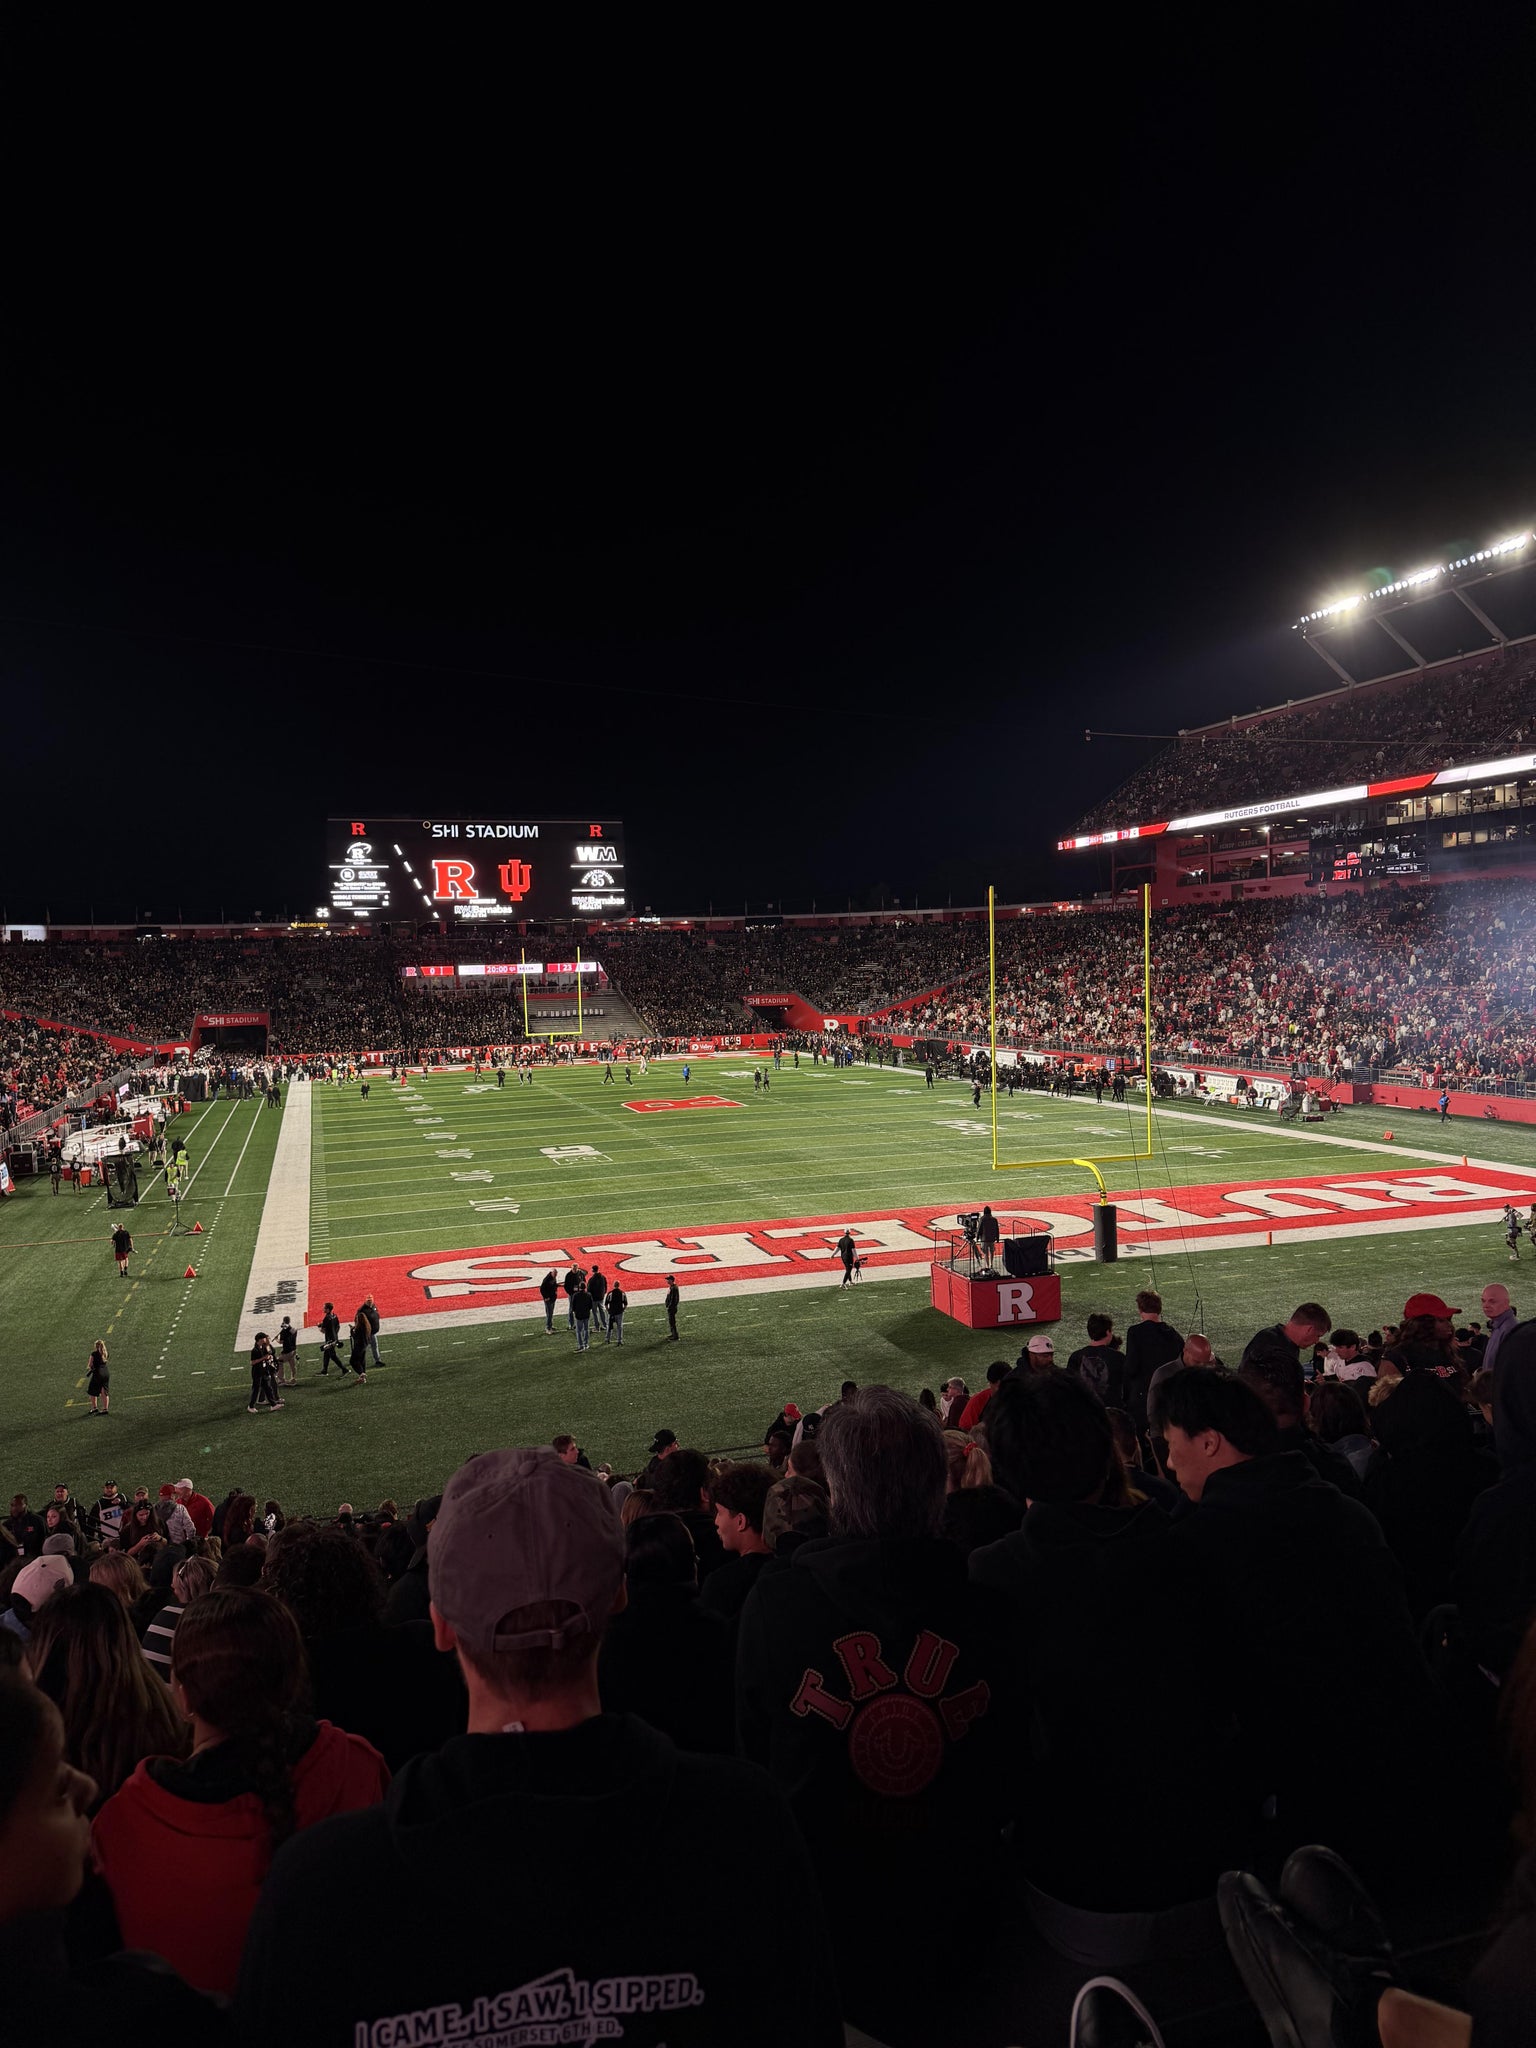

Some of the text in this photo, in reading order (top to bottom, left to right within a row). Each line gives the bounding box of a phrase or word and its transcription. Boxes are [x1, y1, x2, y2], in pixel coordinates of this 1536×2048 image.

[1224, 799, 1301, 820] RUTGERS FOOTBALL
[351, 822, 366, 836] R
[431, 824, 539, 838] SHI STADIUM
[589, 824, 603, 837] R
[576, 846, 618, 861] WM
[432, 859, 479, 900] R
[486, 965, 508, 973] 20:00
[563, 963, 573, 971] 23
[747, 997, 760, 1005] SHI
[208, 1016, 259, 1026] SHI STADIUM
[468, 1196, 521, 1214] 10
[996, 1281, 1037, 1323] R
[789, 1629, 991, 1741] TRUE
[375, 2006, 468, 2048] CAME.
[497, 1986, 569, 2025] SAW.
[598, 1974, 703, 2010] SIPPED.
[475, 2027, 556, 2048] SOMERSET
[562, 2021, 592, 2041] 6TH
[597, 2020, 623, 2036] ED.
